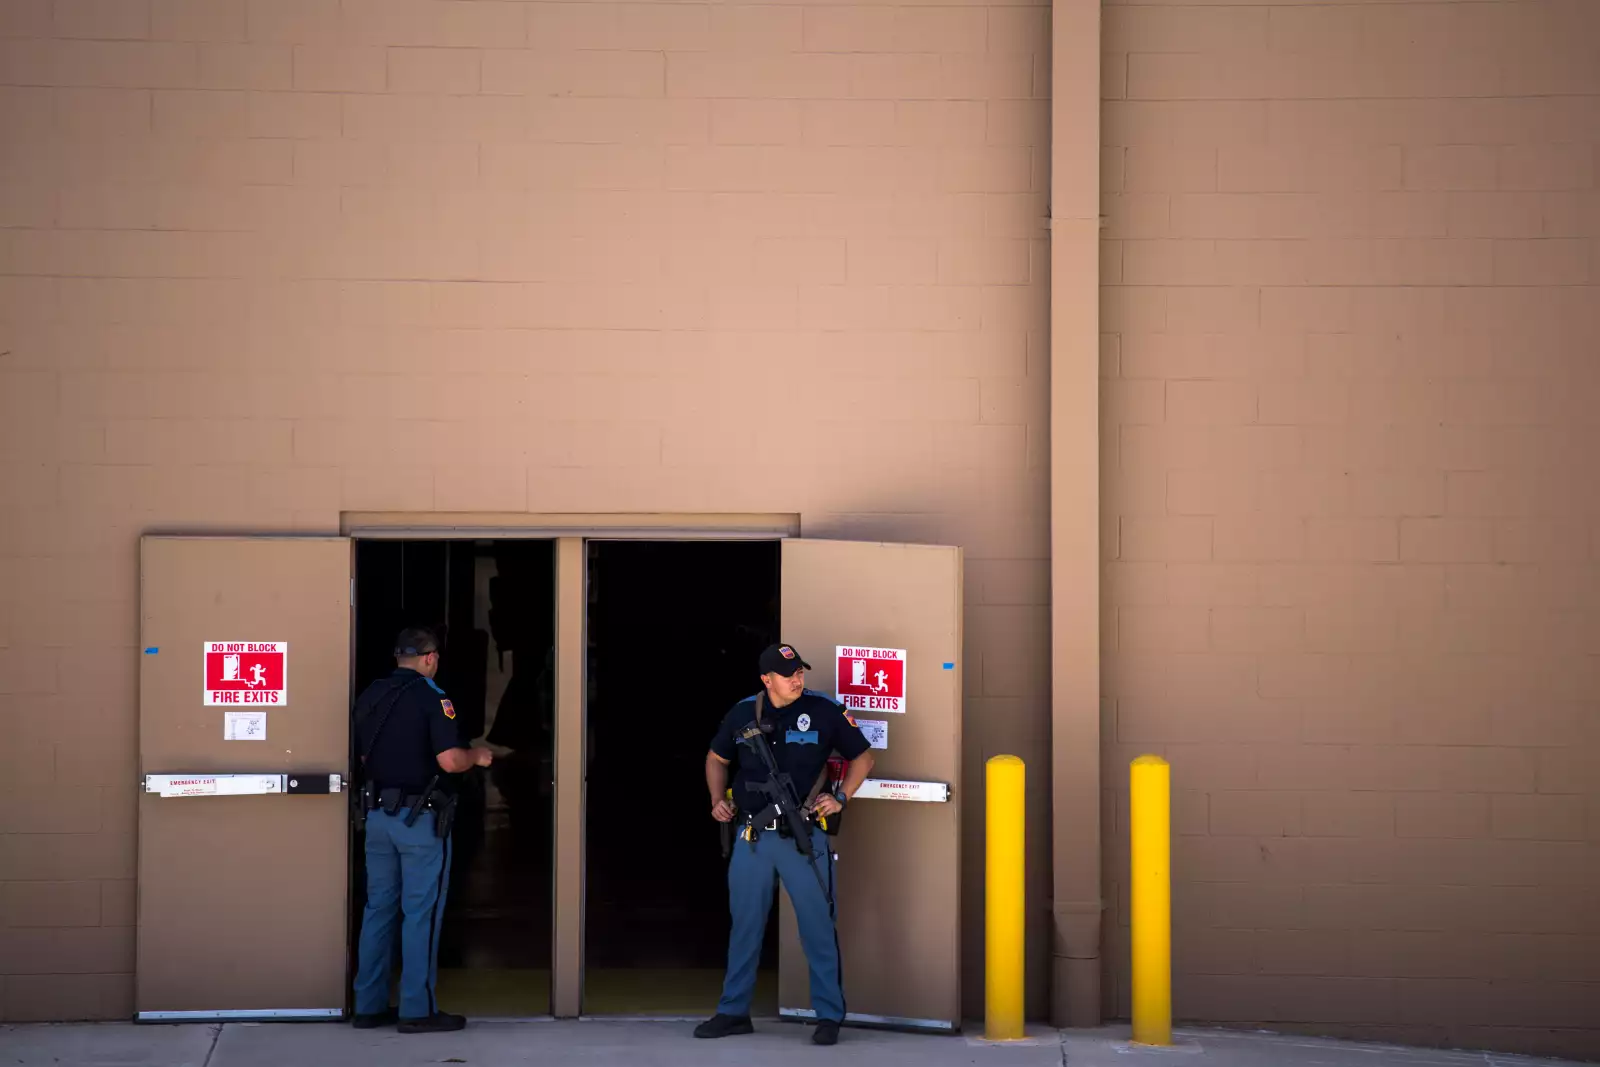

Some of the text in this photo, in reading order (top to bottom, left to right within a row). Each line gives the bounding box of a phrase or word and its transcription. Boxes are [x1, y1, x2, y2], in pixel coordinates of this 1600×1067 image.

[212, 643, 277, 652] DO NOT BLOCK
[842, 648, 898, 659] DO NOT BLOCK
[213, 691, 279, 703] FIRE EXITS
[843, 695, 899, 710] FIRE EXITS
